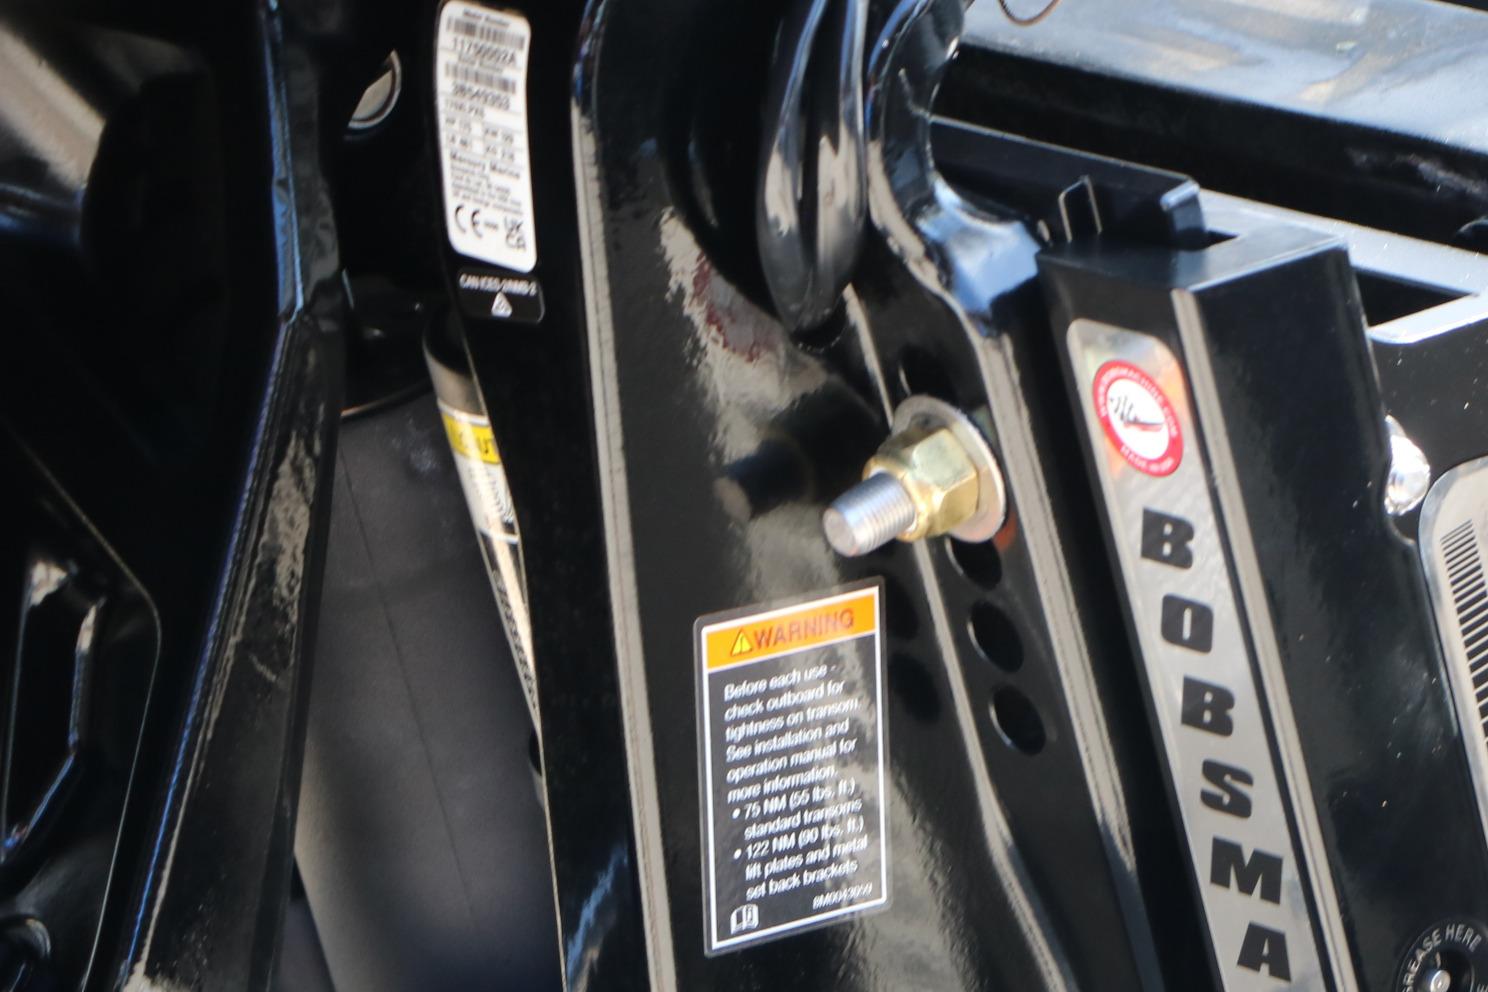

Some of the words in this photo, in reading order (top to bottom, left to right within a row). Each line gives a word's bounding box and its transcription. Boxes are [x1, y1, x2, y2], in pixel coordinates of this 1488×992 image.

[754, 608, 854, 649] WARNING
[724, 679, 767, 701] Before
[769, 668, 800, 688] each
[804, 664, 827, 680] use
[724, 699, 764, 722] check
[766, 685, 825, 710] outboard
[826, 679, 846, 693] for
[724, 715, 785, 743] tightness
[786, 710, 803, 724] on
[725, 744, 751, 763] See
[754, 726, 822, 754] installation
[824, 717, 849, 737] and
[726, 756, 788, 785] operation
[789, 739, 838, 765] manual
[838, 736, 858, 753] for
[727, 783, 761, 803] more
[762, 765, 838, 794] information.
[743, 811, 801, 841] standard
[803, 799, 863, 821] transoms
[744, 802, 761, 820] 75
[763, 795, 786, 816] NM
[789, 790, 810, 811] (55
[745, 840, 770, 860] 122
[772, 834, 796, 854] NM
[798, 827, 819, 849] (90
[745, 863, 763, 881] lift
[764, 854, 804, 880] plates
[805, 844, 831, 865] and
[832, 834, 868, 856] metal
[746, 882, 766, 901] set
[768, 872, 802, 896] back
[803, 859, 859, 887] brackets
[1445, 923, 1482, 953] HERE
